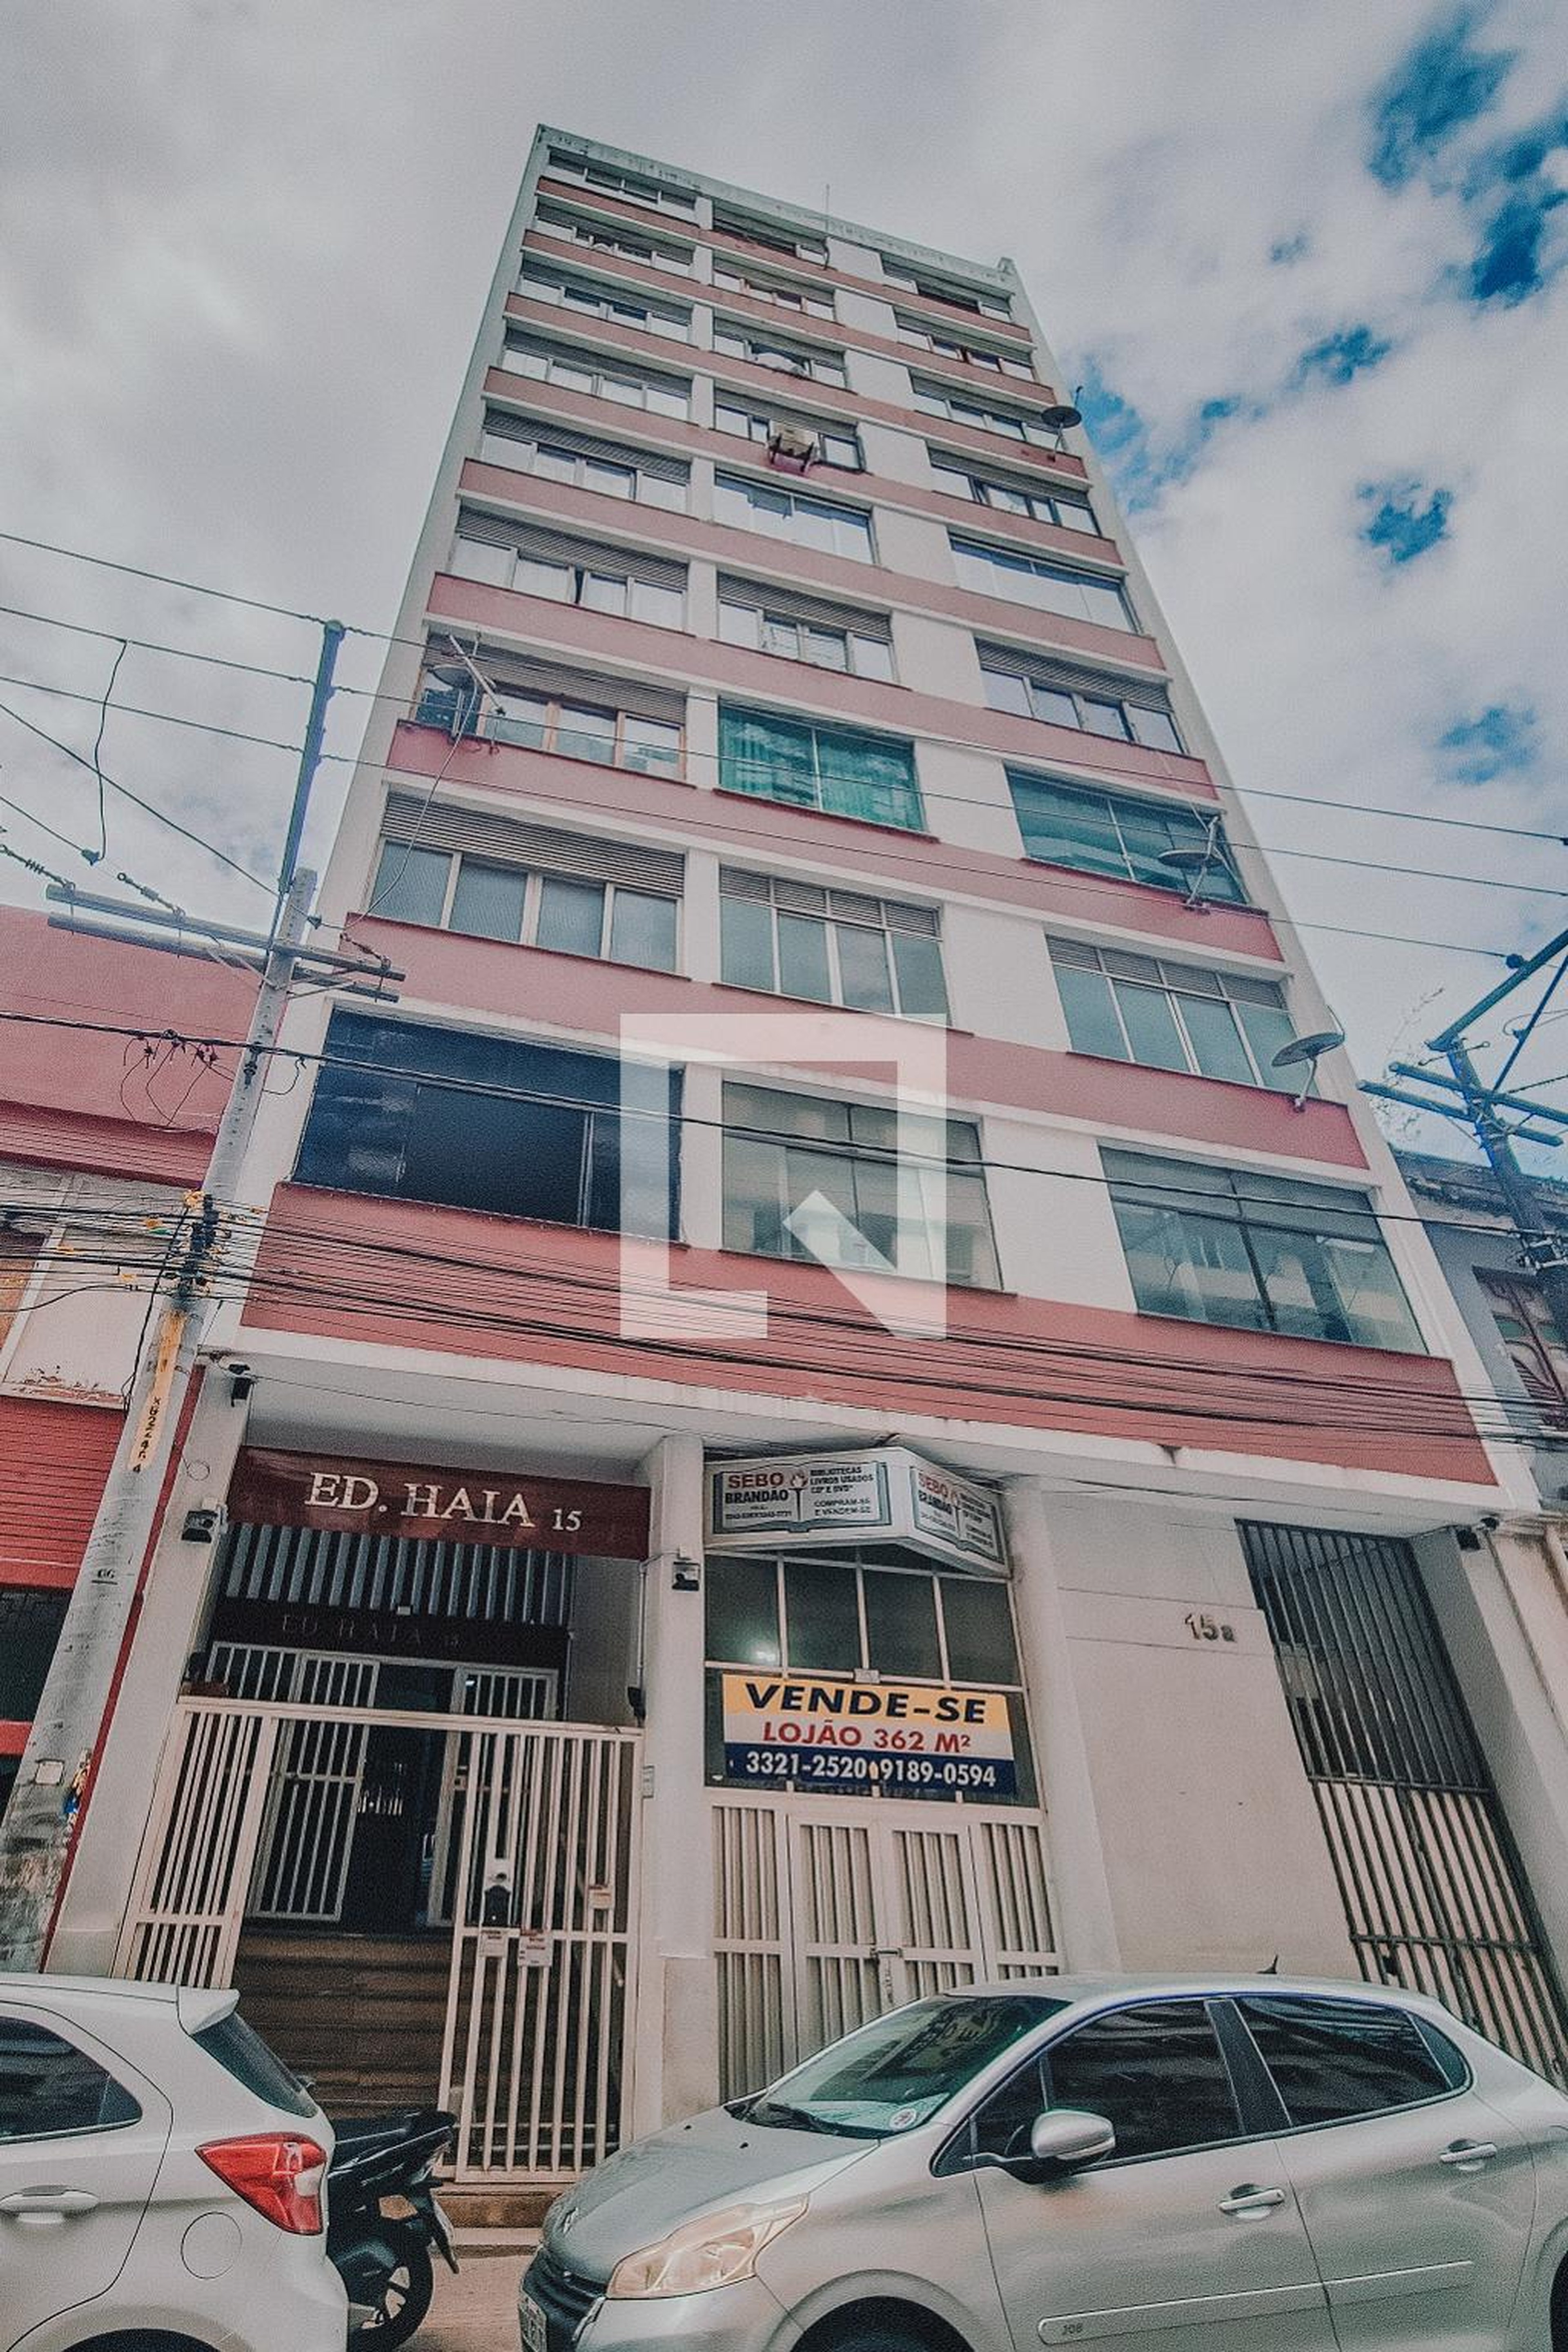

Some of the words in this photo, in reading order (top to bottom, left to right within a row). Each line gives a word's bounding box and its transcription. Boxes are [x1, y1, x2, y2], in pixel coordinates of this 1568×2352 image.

[728, 1472, 784, 1489] SEBO
[810, 1477, 839, 1485] LIVROS
[841, 1474, 874, 1483] USADOS
[304, 1472, 388, 1512] ED.
[400, 1482, 536, 1528] HAIA
[552, 1508, 582, 1532] 15
[745, 1683, 987, 1724] VENDE-SE
[763, 1719, 862, 1746] LOJÃO
[874, 1728, 924, 1751] 362
[746, 1751, 867, 1779] 3321-2520
[880, 1758, 996, 1787] 9189-0594
